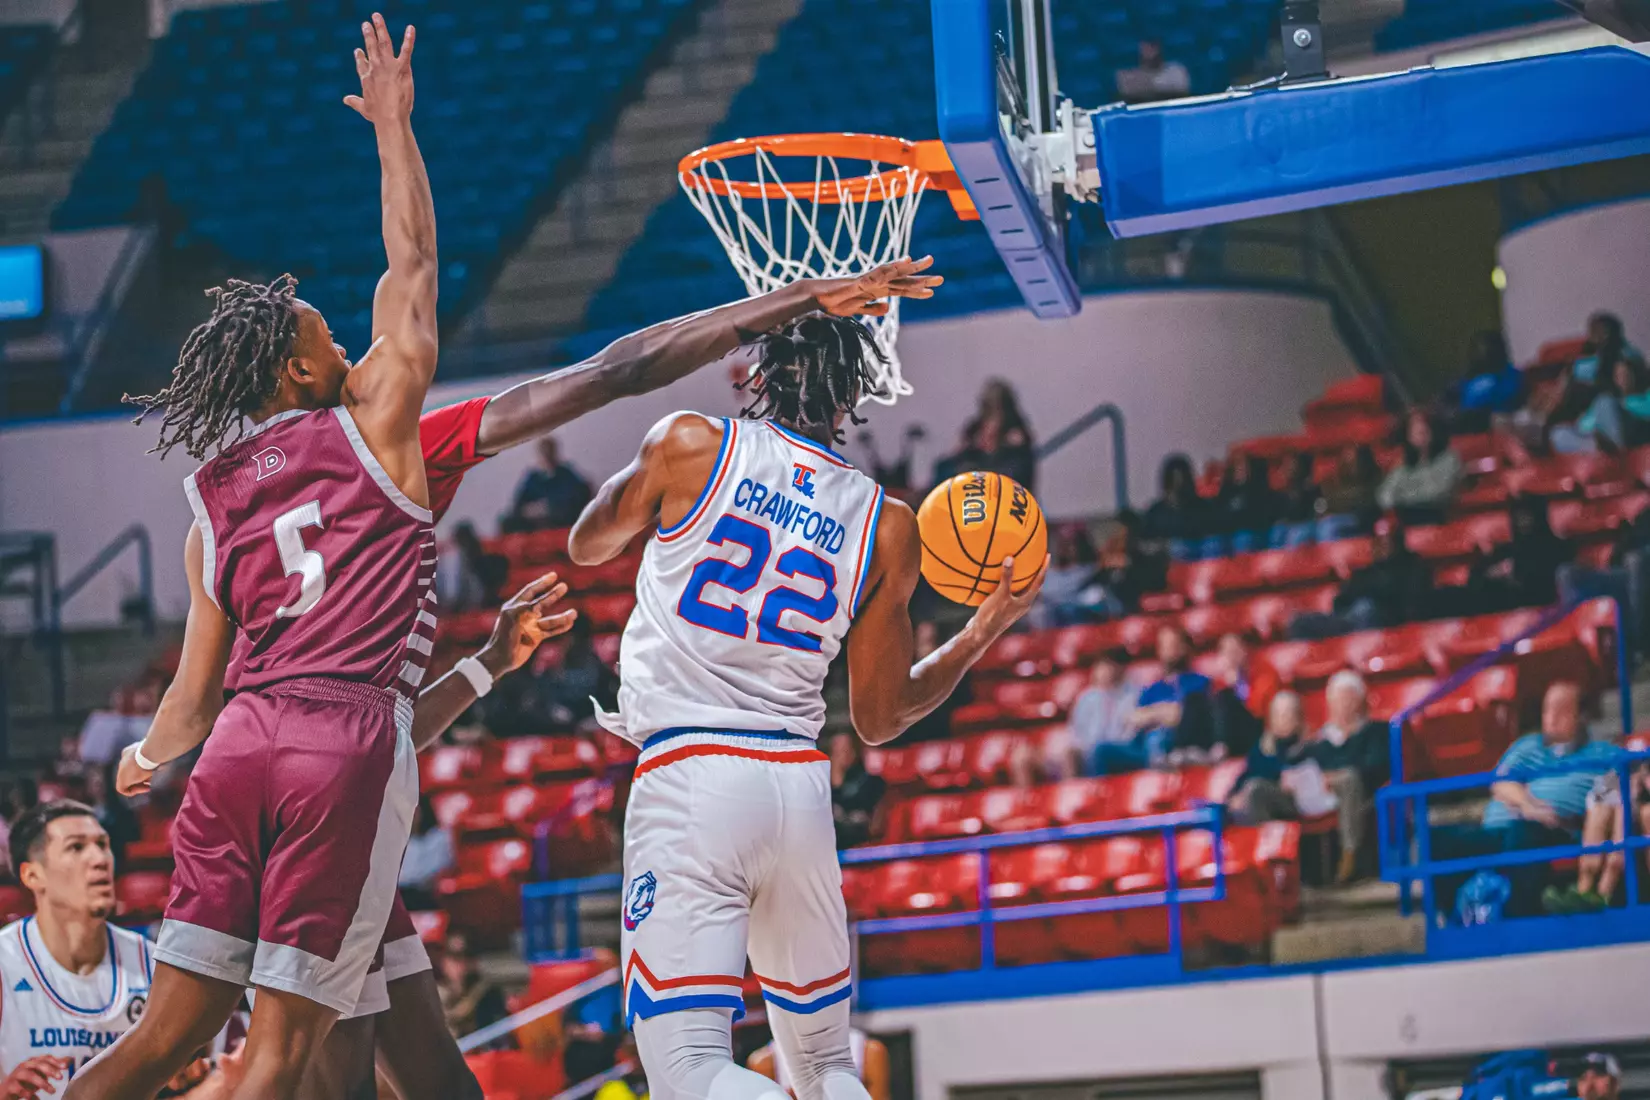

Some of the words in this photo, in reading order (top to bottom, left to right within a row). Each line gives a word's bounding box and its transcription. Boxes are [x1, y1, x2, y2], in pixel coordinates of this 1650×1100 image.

[273, 500, 325, 619] 5
[734, 478, 845, 555] CRAWFORD
[678, 513, 838, 652] 22
[29, 1027, 122, 1049] LOUISIAN
